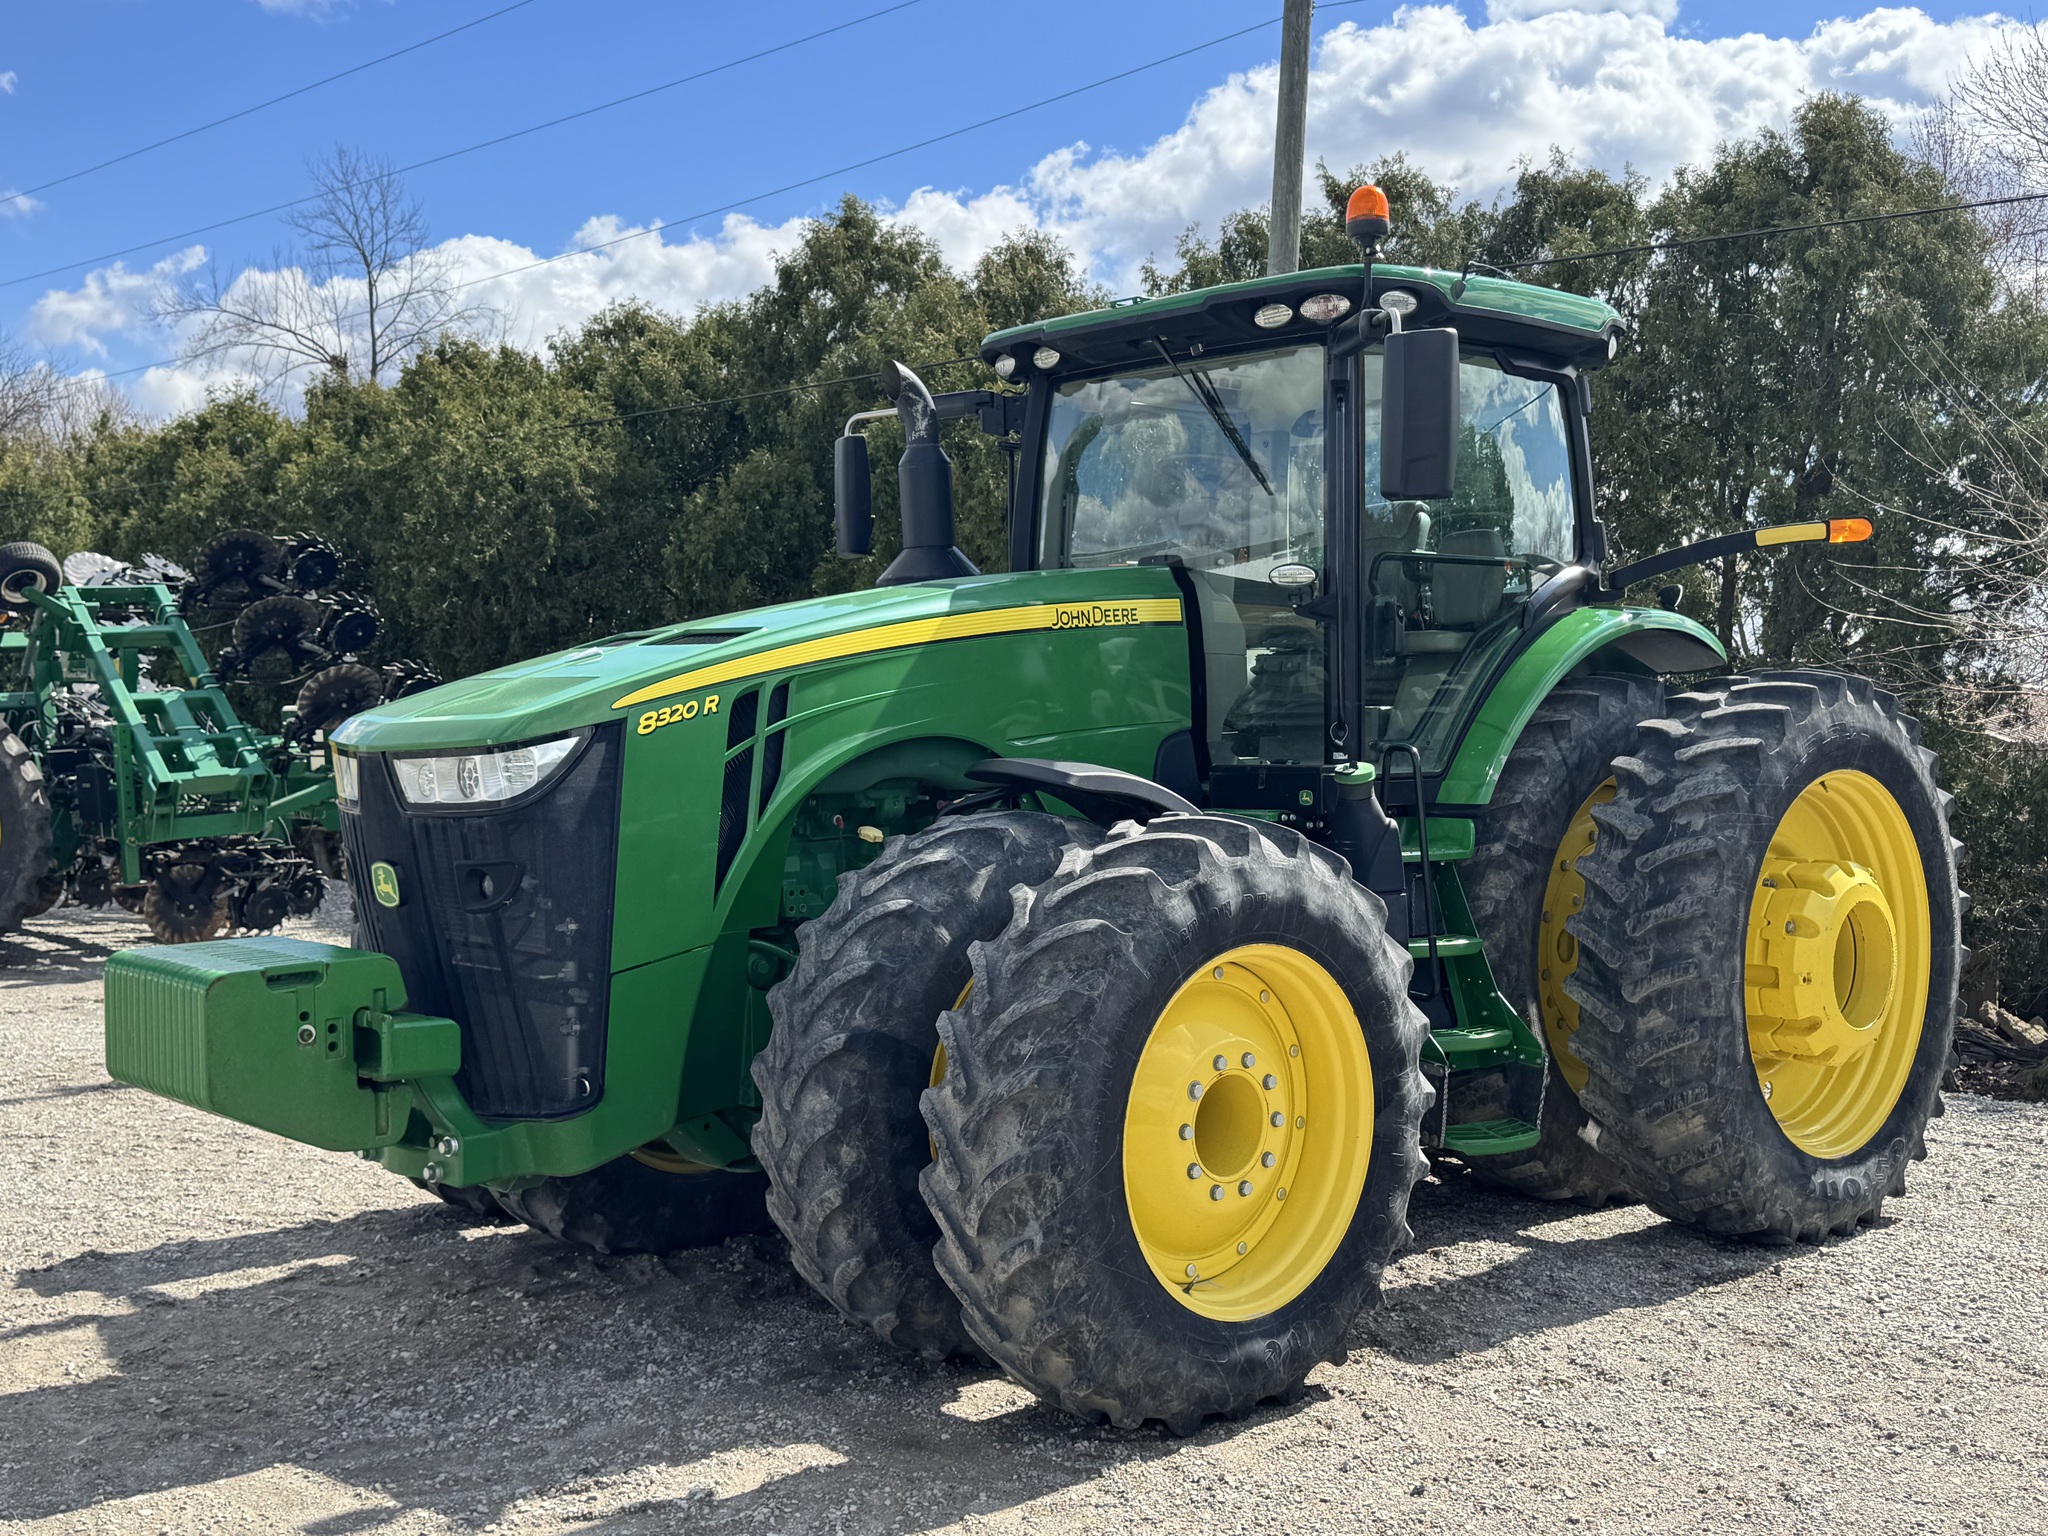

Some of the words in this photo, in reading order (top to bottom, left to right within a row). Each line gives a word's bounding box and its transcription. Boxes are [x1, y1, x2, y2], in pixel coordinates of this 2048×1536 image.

[1051, 608, 1091, 627] JOHN
[1092, 605, 1139, 624] DEERE
[637, 700, 699, 734] 8320
[703, 695, 720, 716] R
